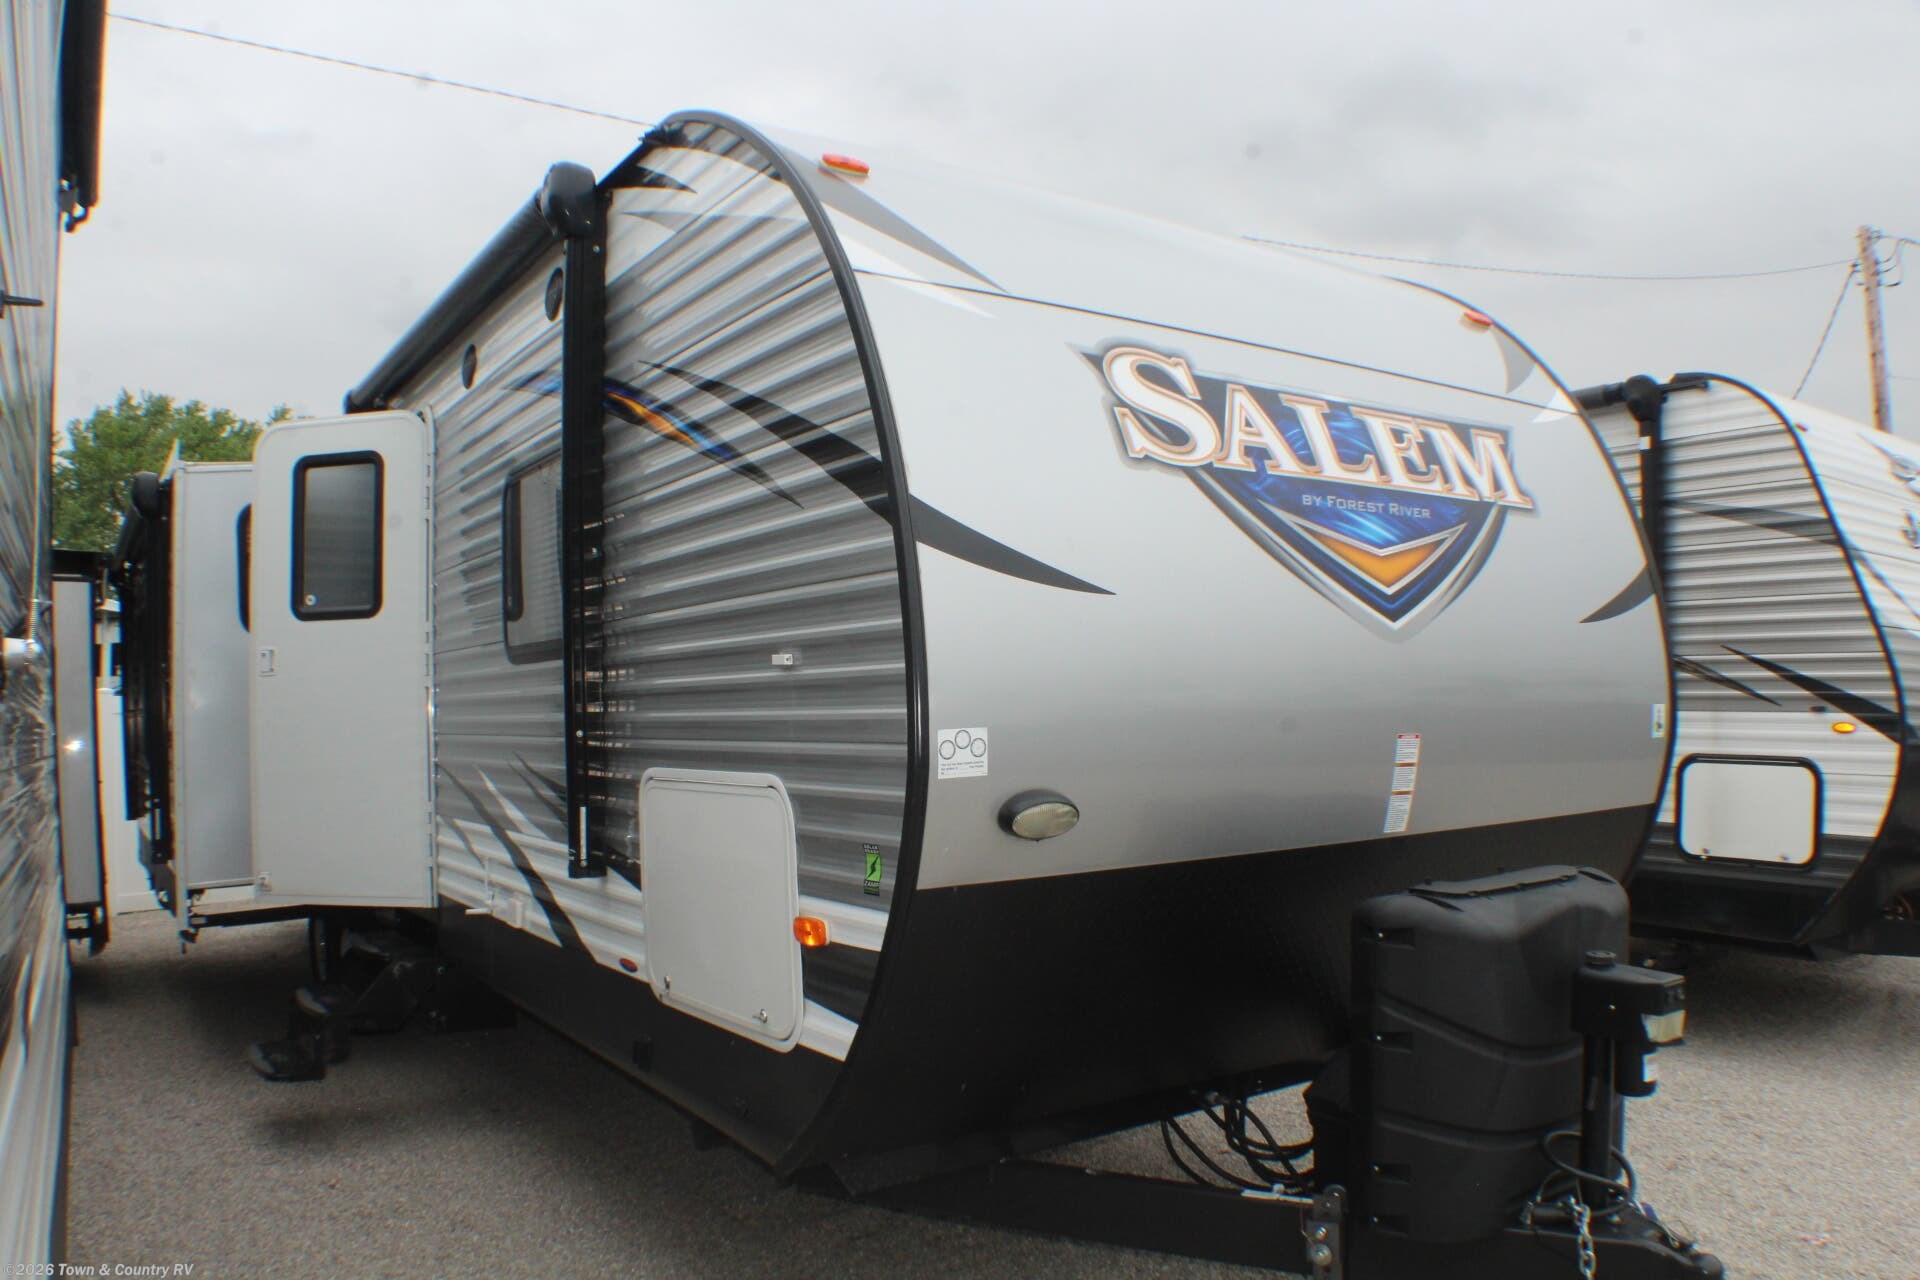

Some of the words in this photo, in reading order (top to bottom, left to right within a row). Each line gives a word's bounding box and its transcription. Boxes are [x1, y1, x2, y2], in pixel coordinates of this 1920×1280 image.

[1102, 346, 1535, 509] SALEM
[1302, 494, 1323, 507] BY
[1326, 495, 1385, 514] FOREST
[1388, 503, 1432, 519] RIVER
